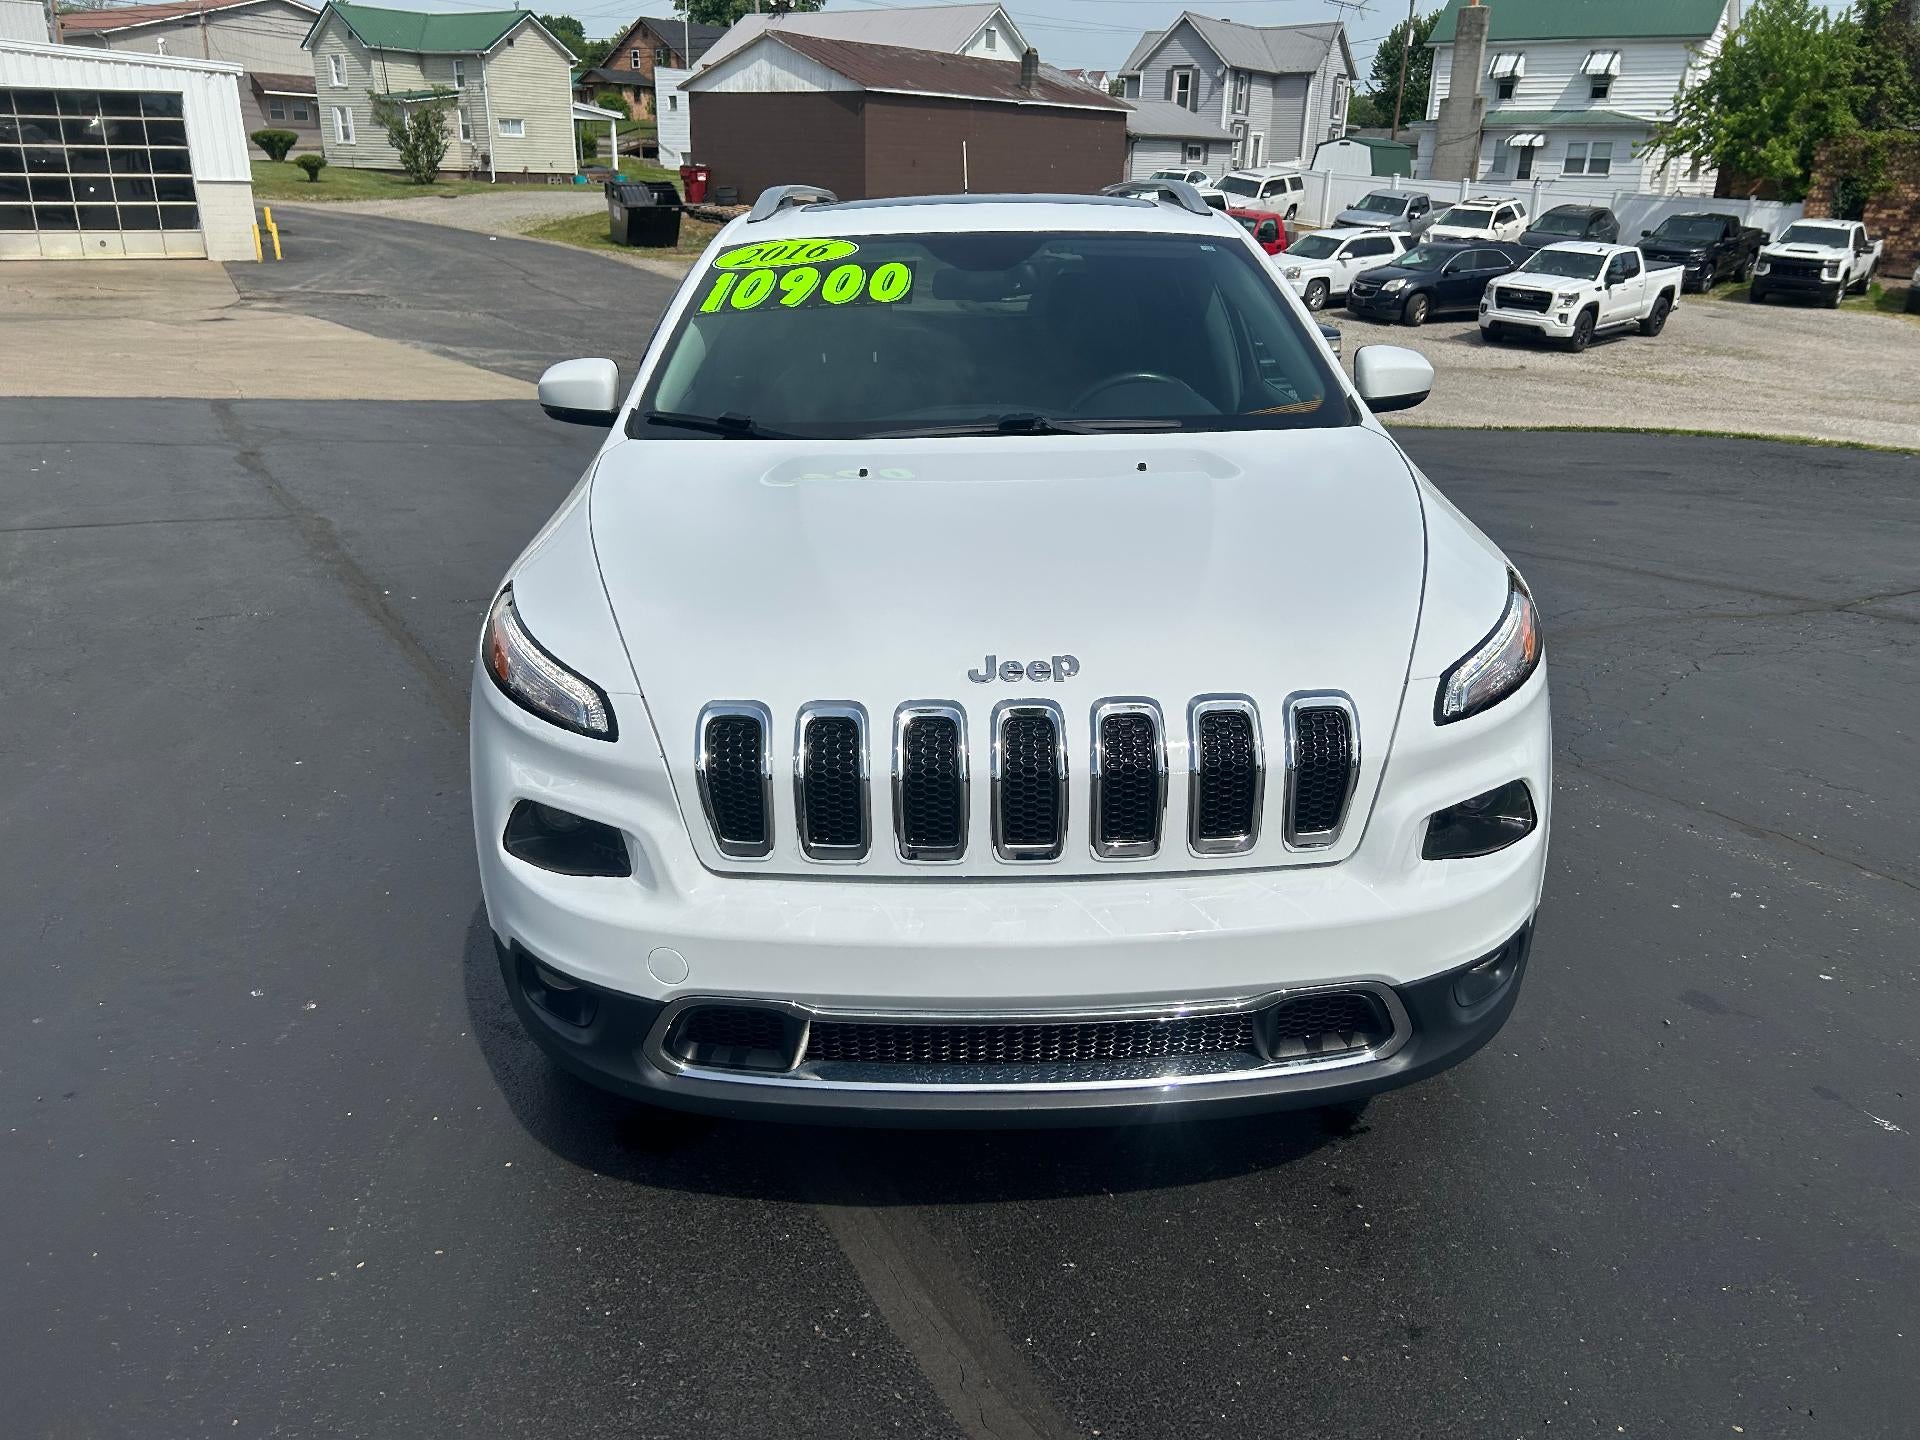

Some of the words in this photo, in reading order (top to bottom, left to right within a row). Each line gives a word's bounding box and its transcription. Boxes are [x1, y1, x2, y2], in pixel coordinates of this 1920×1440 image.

[734, 243, 829, 266] 2016
[699, 262, 912, 313] 10900
[967, 654, 1080, 684] Jeep
